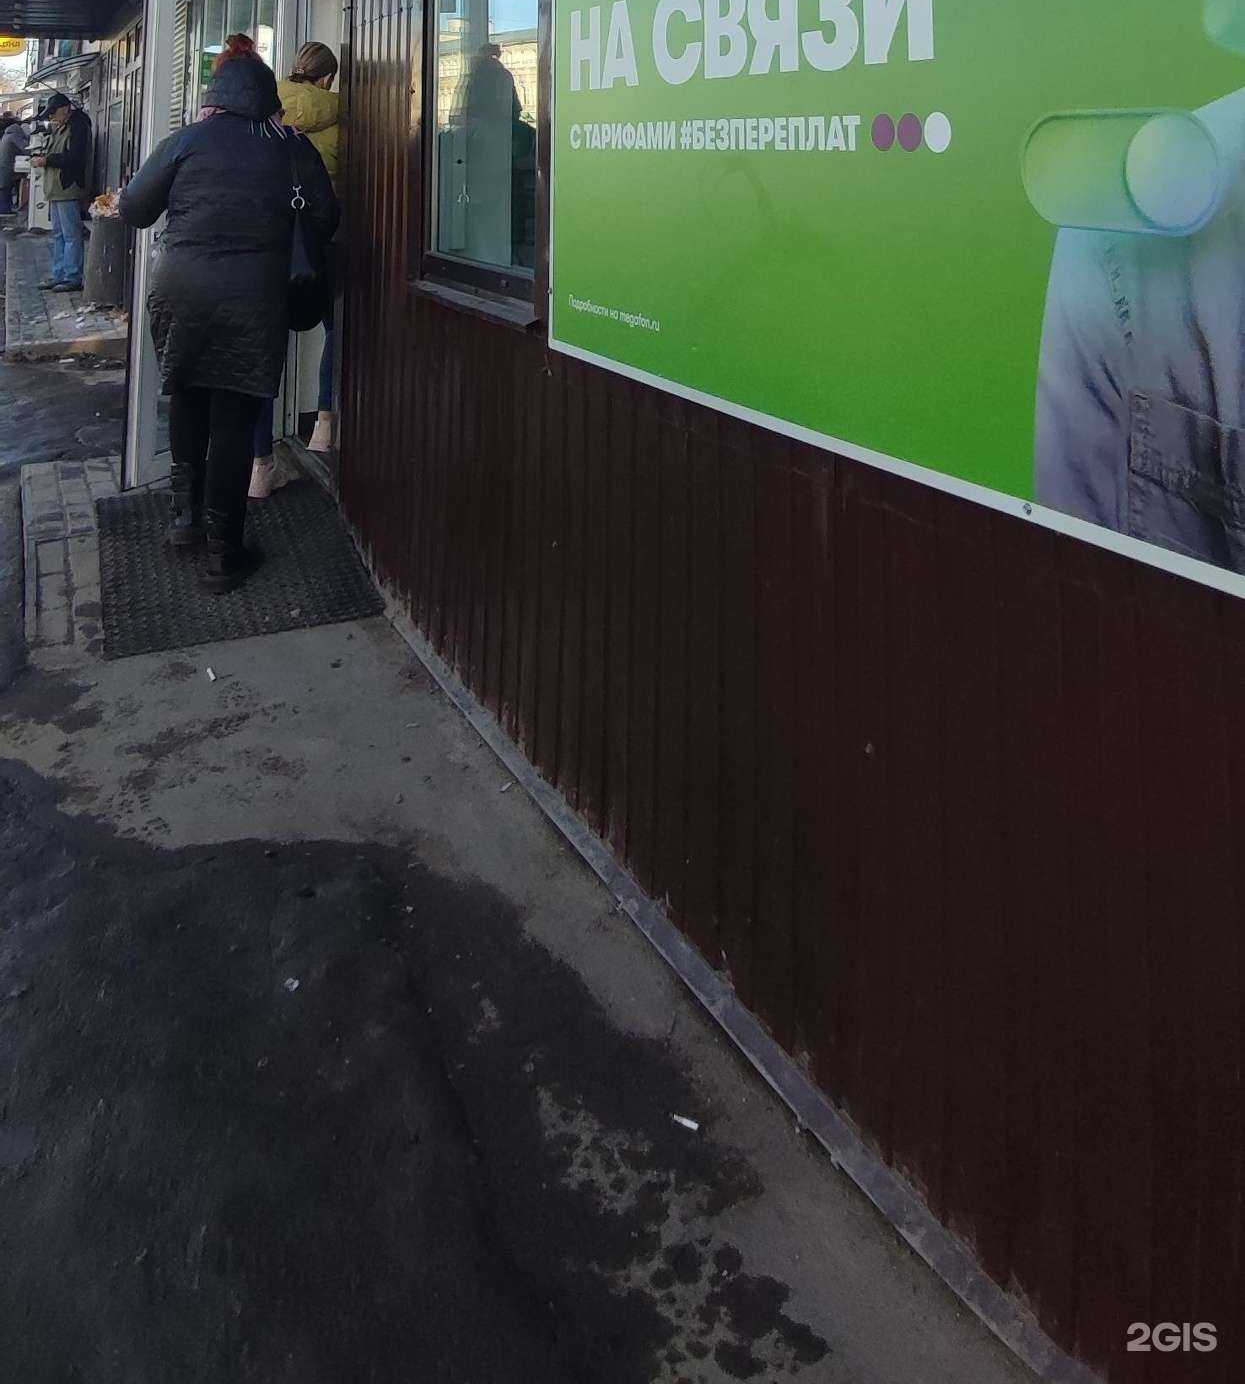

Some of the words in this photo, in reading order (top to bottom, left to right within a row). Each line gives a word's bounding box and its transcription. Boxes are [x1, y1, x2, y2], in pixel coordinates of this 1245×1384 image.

[569, 0, 640, 92] НА
[569, 123, 581, 150] С
[584, 119, 677, 150] ТАРИФАМИ
[680, 115, 861, 152] #БЕЗПЕРЕПЛАТ
[568, 294, 609, 317] Подробности
[610, 309, 619, 320] на
[620, 312, 660, 331] megafon.ru
